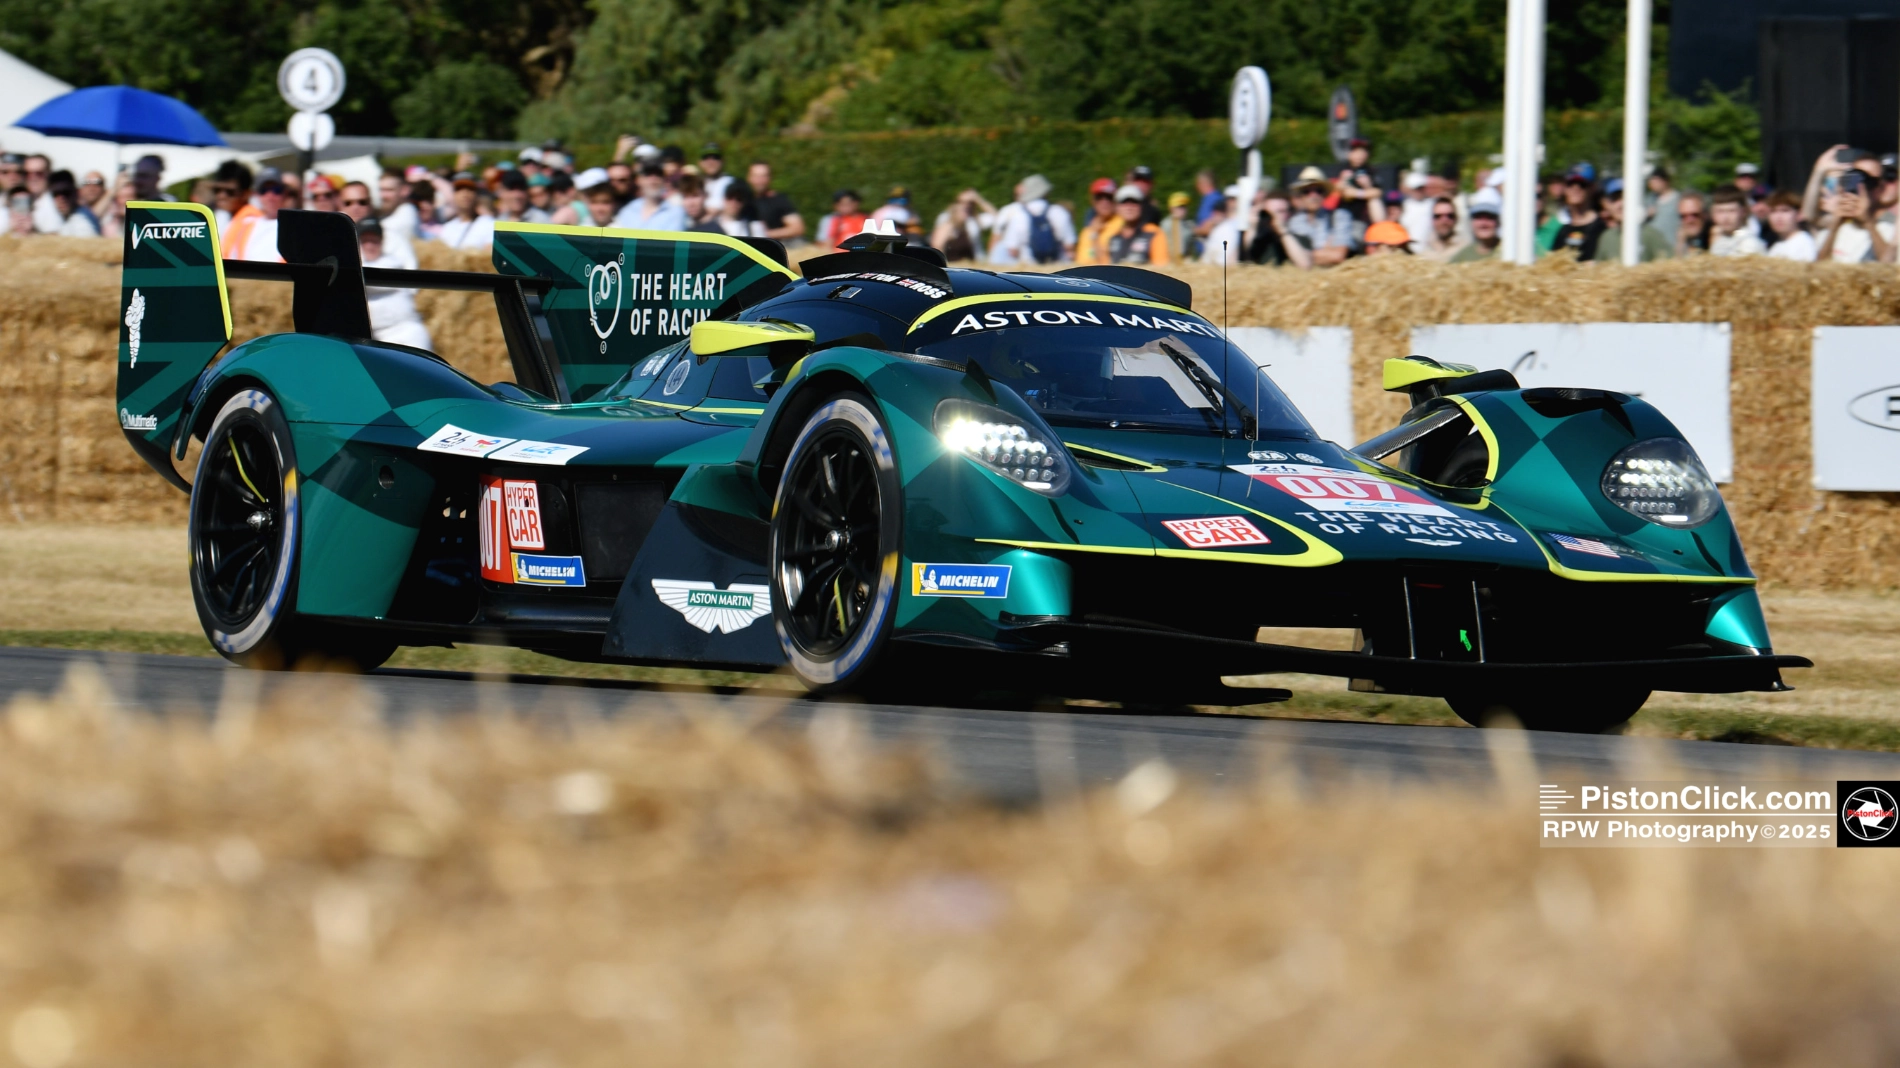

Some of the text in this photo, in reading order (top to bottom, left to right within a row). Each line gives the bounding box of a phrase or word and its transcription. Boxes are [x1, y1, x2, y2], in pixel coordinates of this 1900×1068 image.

[303, 67, 317, 96] 4
[132, 222, 206, 249] VALKYRIE
[631, 273, 663, 300] THE
[669, 273, 727, 300] HEART
[909, 282, 947, 299] ROSS
[630, 308, 711, 336] OF RACI
[951, 310, 1103, 335] ASTON
[506, 486, 536, 508] HYPER
[1276, 476, 1396, 501] 007
[509, 508, 541, 542] CAR
[1170, 518, 1247, 531] HYPER
[1295, 511, 1503, 532] THE HEART
[1183, 527, 1262, 544] CAR
[1318, 522, 1518, 543] OF RACING
[528, 564, 575, 577] MICHELIN
[939, 575, 998, 587] MICHELIN
[689, 592, 752, 607] ASTON MARTIN
